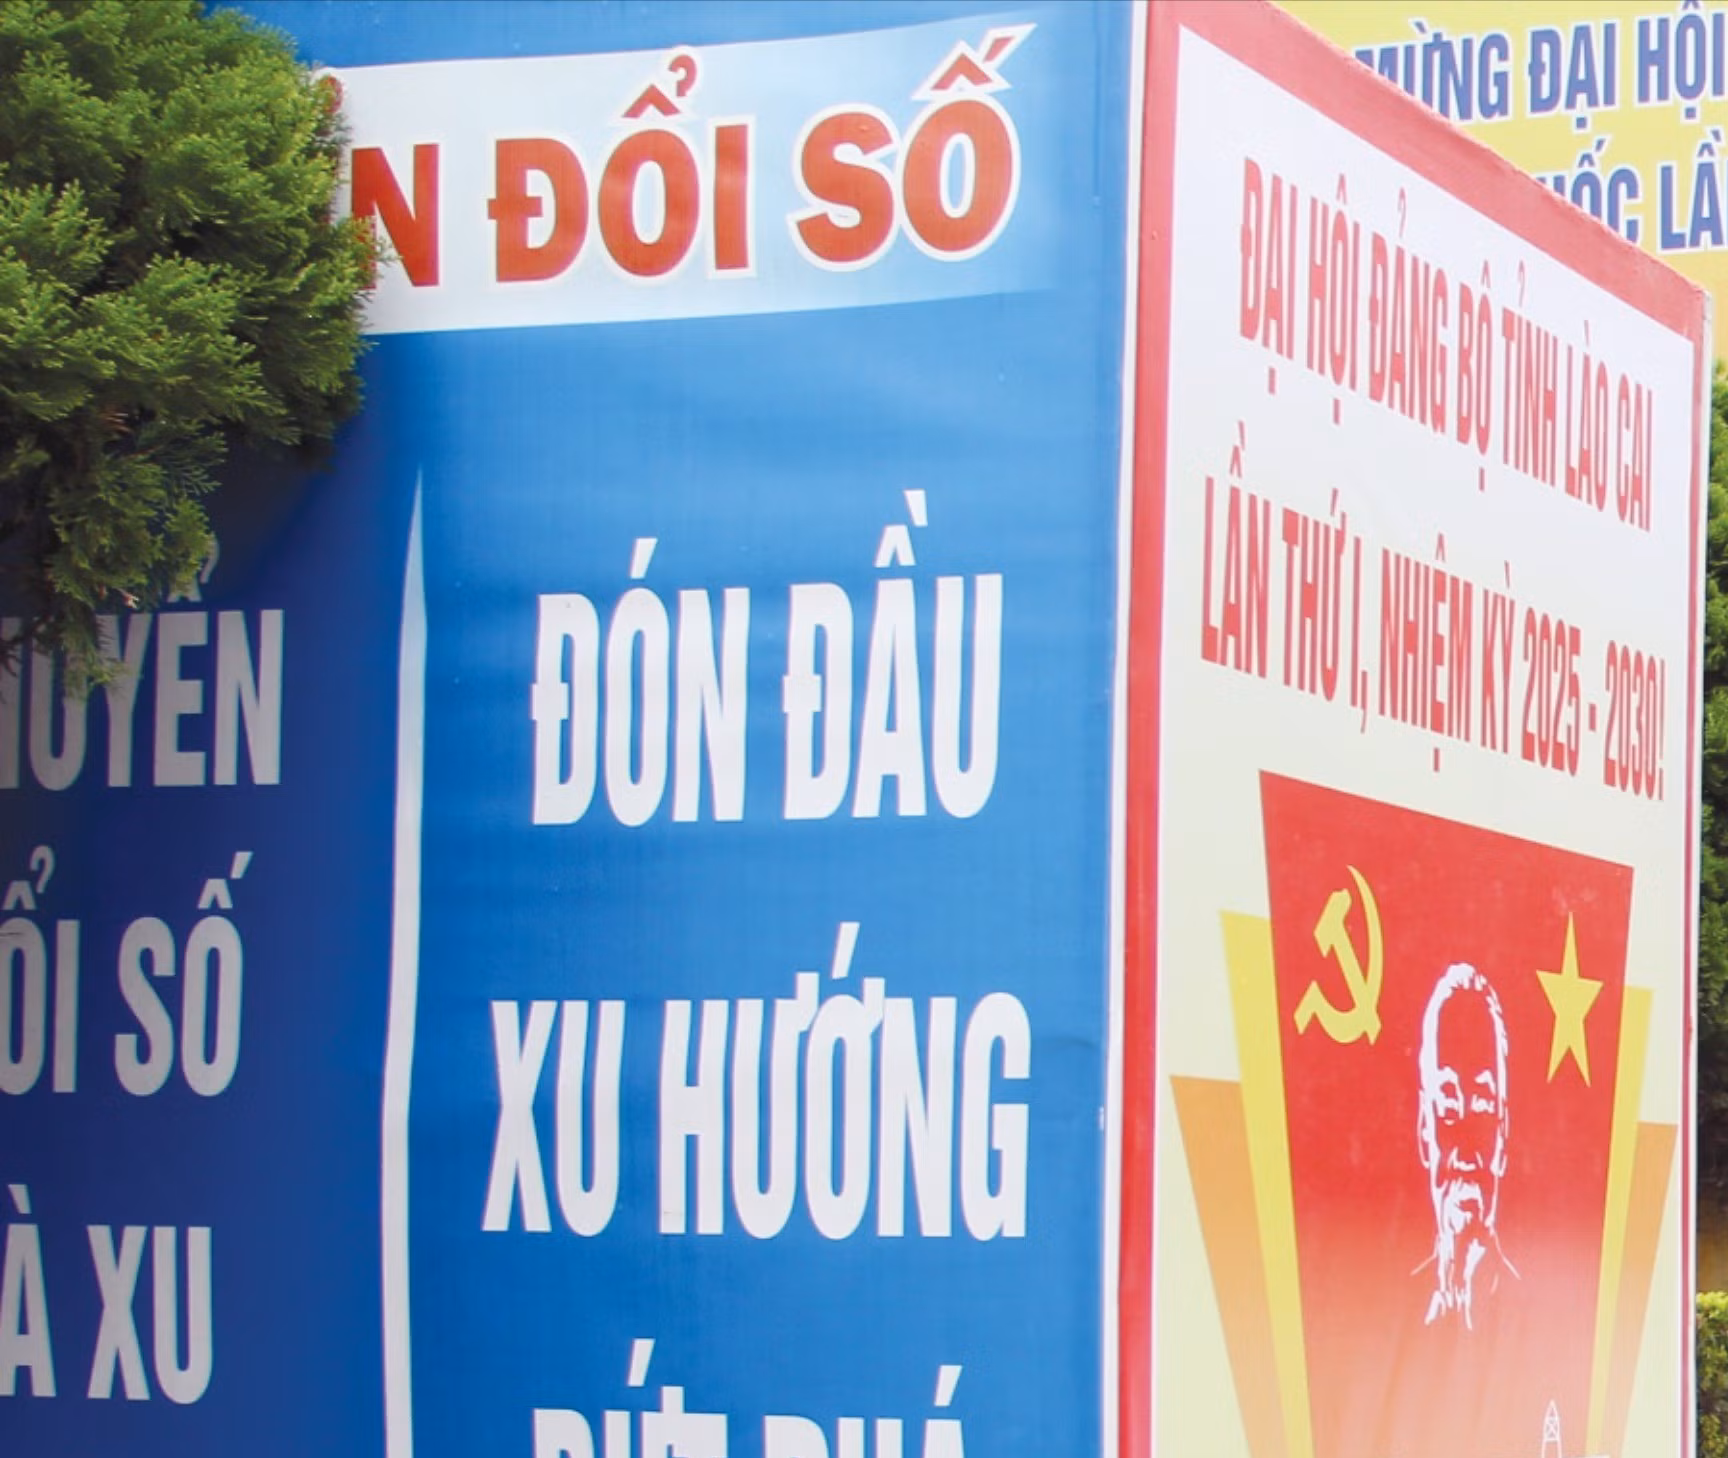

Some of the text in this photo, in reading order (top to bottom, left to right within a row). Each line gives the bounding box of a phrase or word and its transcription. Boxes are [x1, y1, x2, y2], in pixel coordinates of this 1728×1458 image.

[488, 54, 753, 282] ĐỔI
[797, 35, 1018, 265] SỐ
[1528, 22, 1617, 130] ĐẠI
[1637, 0, 1725, 119] HỘI
[1538, 138, 1640, 246] ỐC
[1240, 157, 1654, 533] ĐẠI HỘI ĐẢNG BỘ TỈNH LÀO CAI
[531, 489, 1003, 828] ĐÓN ĐẦU
[1200, 420, 1271, 678] LẦN
[1281, 487, 1347, 704] THỨ
[1378, 532, 1474, 773] NHIỆM
[1481, 560, 1516, 755] KỲ
[1521, 606, 1582, 777] 2025
[1603, 639, 1667, 802] 2030!
[0, 845, 253, 1096] ỔI SỐ
[482, 922, 1032, 1241] XU HƯỚNG
[0, 1184, 213, 1404] À XU
